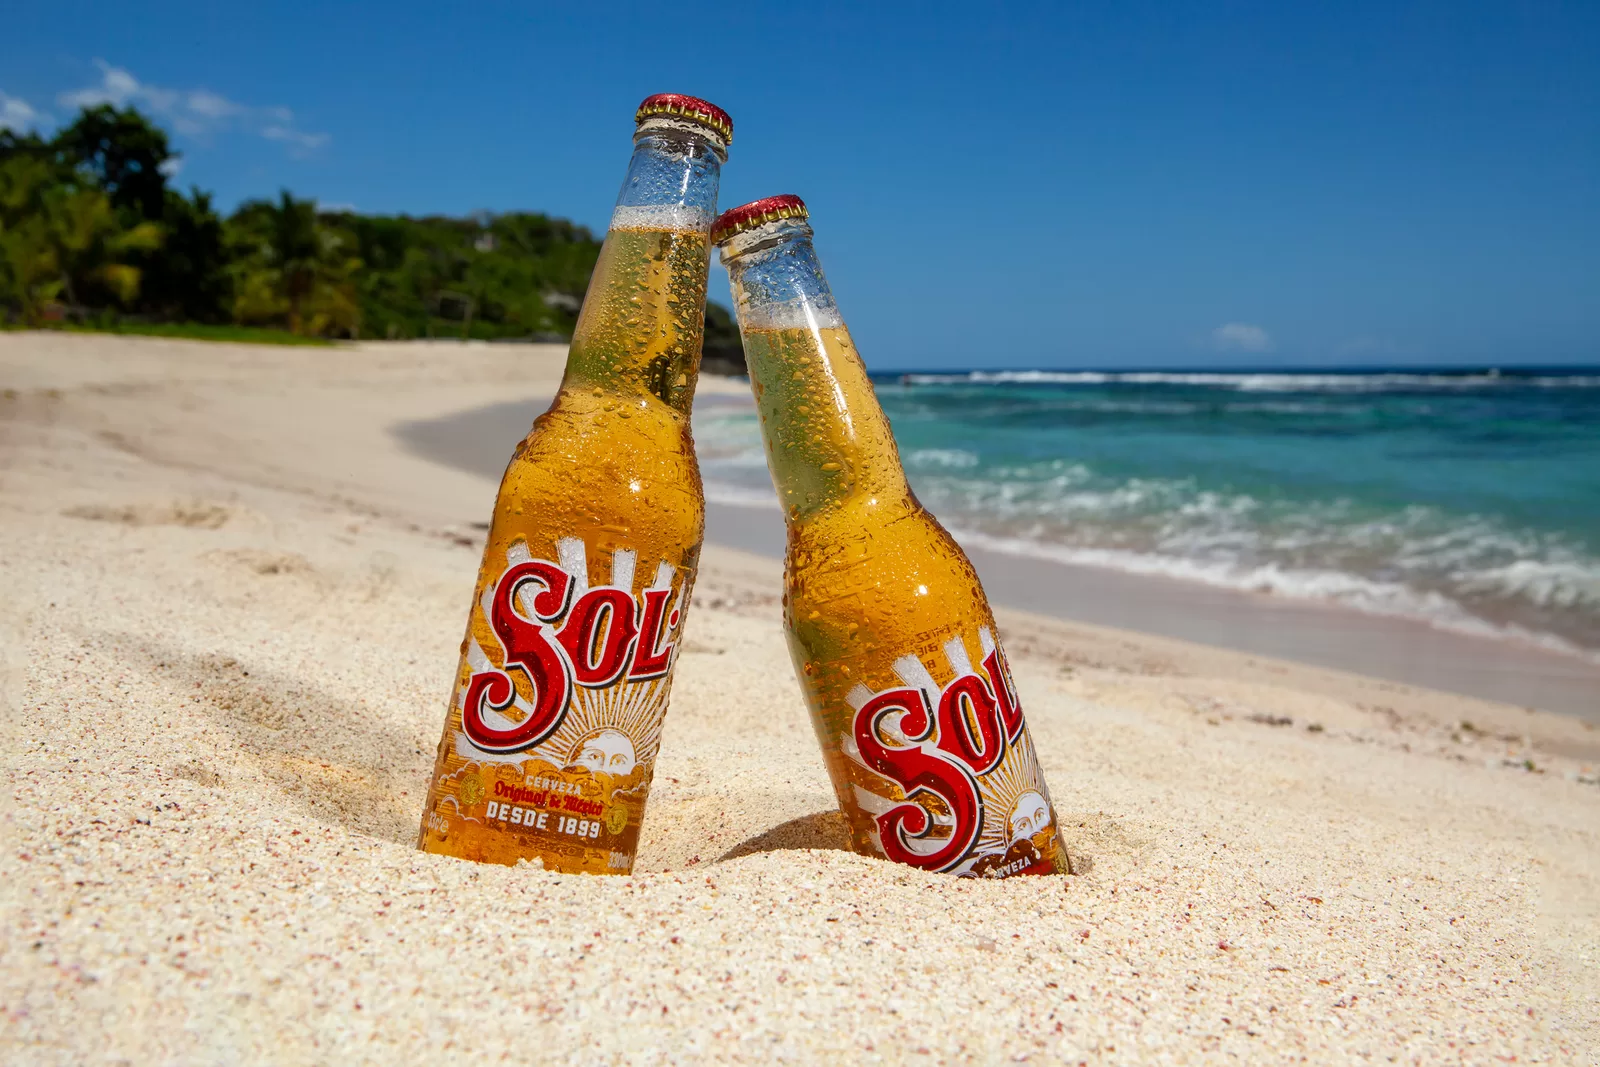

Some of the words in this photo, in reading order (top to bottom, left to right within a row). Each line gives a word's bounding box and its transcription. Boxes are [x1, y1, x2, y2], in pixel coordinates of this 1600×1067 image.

[494, 780, 548, 804] Original
[525, 775, 581, 796] CERVEZA
[486, 800, 549, 830] DESDE
[558, 815, 601, 839] 1899
[983, 855, 1031, 880] RVEZA
